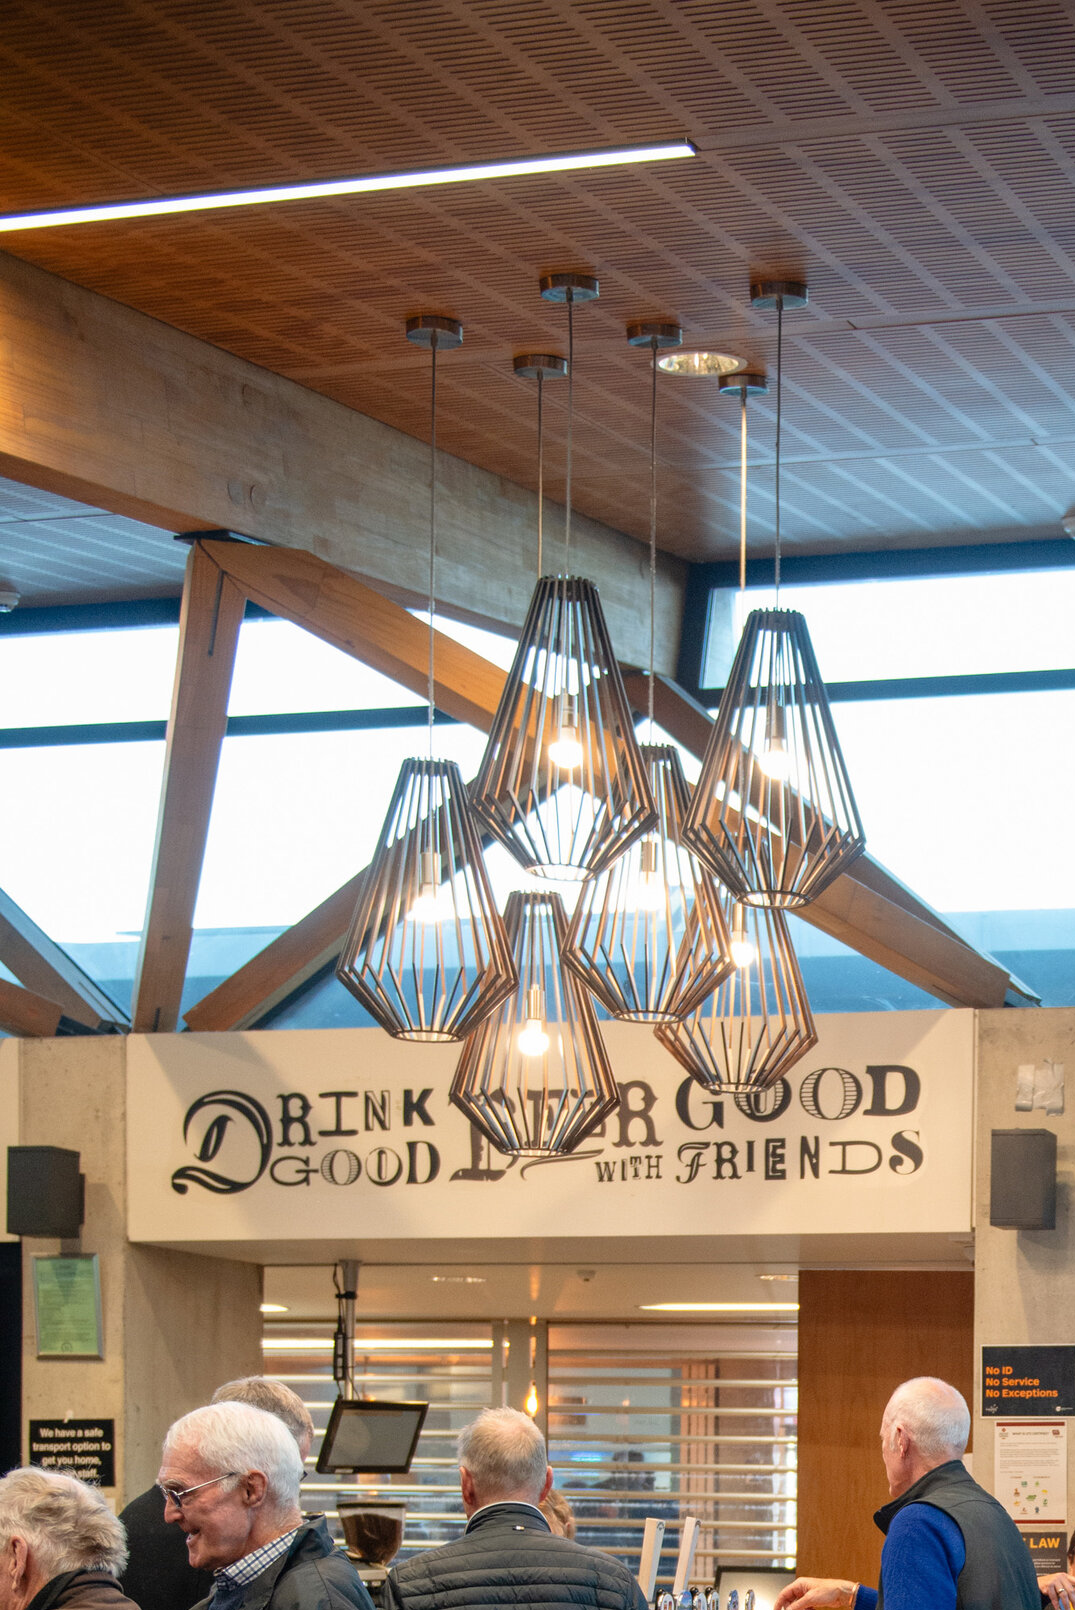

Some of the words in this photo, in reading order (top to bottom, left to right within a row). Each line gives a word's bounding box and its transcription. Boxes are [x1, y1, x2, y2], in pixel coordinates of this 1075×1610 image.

[172, 1088, 436, 1194] DRINK
[675, 1065, 921, 1131] GOOD
[269, 1141, 440, 1187] GOOD
[595, 1154, 663, 1182] WITH
[676, 1130, 924, 1184] FRIENDS
[985, 1366, 1000, 1375] No
[1002, 1366, 1013, 1375] ID
[985, 1378, 1000, 1386] No
[1002, 1377, 1040, 1386] Service
[985, 1389, 1000, 1398] No
[1002, 1388, 1059, 1399] Exceptions
[40, 1428, 54, 1438] We
[55, 1428, 75, 1438] have
[77, 1430, 83, 1438] a
[84, 1428, 103, 1438] safe
[32, 1442, 71, 1453] transport
[72, 1442, 100, 1453] option
[101, 1442, 112, 1451] to
[42, 1456, 56, 1466] get
[57, 1456, 73, 1466] you
[1030, 1538, 1060, 1548] LAW
